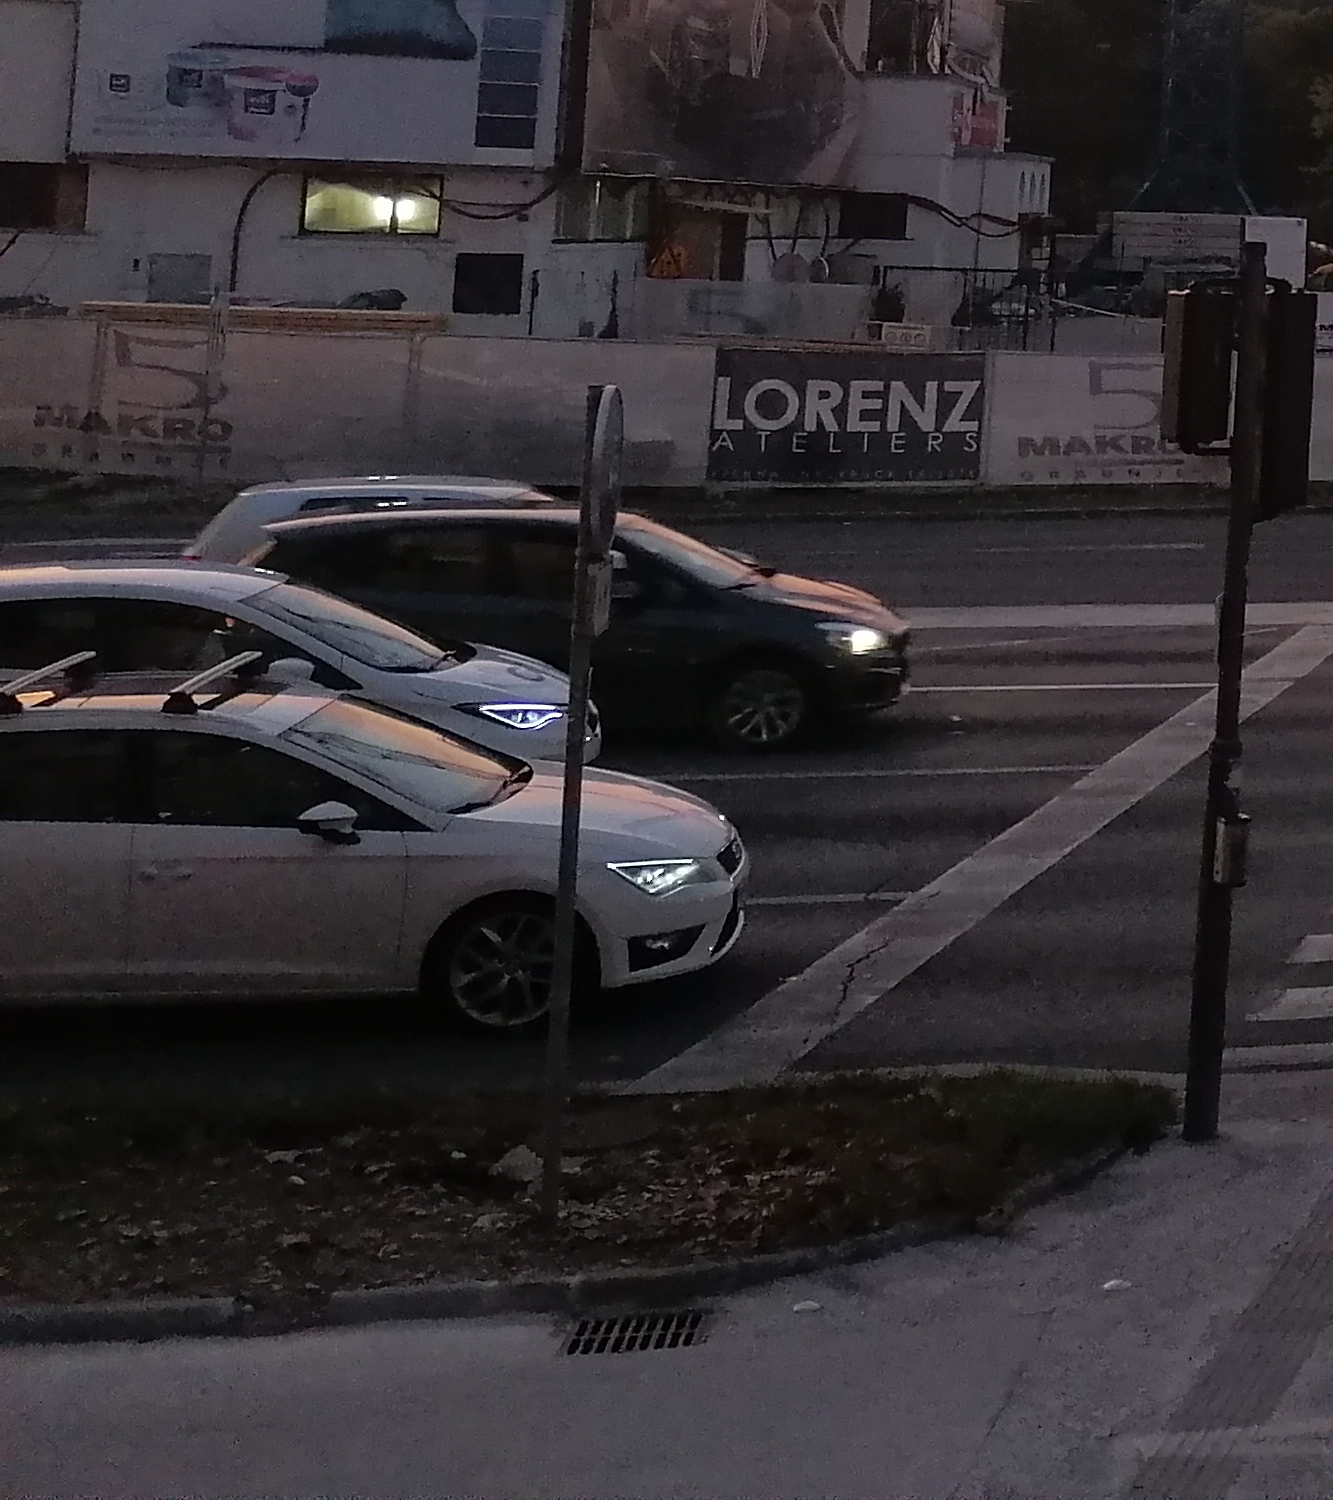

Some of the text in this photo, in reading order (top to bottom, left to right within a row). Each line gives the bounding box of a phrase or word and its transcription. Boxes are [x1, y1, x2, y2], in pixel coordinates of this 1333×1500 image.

[33, 404, 234, 443] MAKRO
[713, 375, 981, 433] LORENZ
[711, 431, 979, 454] ATELIERS
